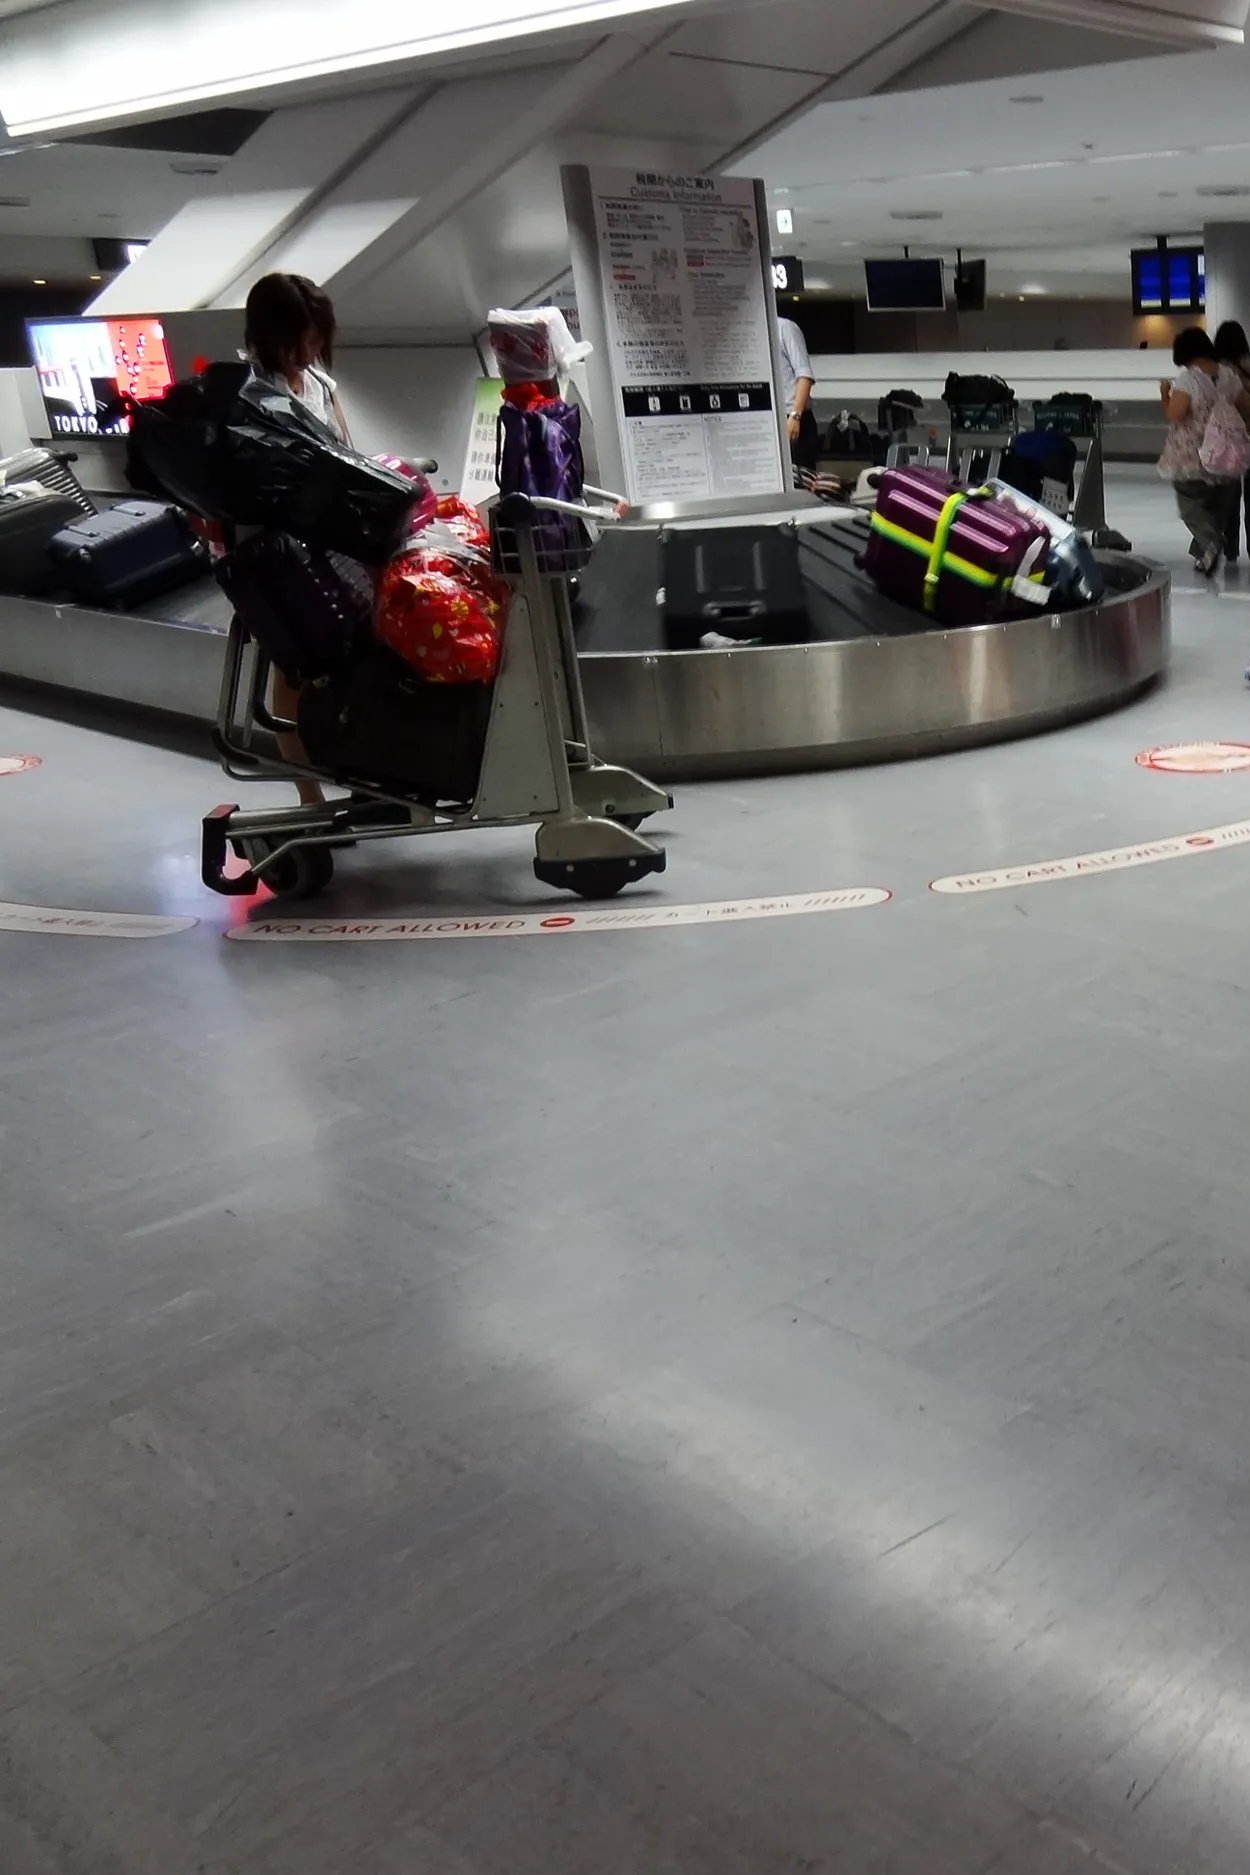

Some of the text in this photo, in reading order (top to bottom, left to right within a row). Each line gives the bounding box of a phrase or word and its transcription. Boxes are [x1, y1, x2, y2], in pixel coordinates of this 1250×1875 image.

[630, 187, 723, 204] Customs Information
[54, 415, 98, 433] TOKYO
[955, 844, 1180, 888] NO CART ALLOWED
[252, 919, 525, 935] NO CART ALLOWED
